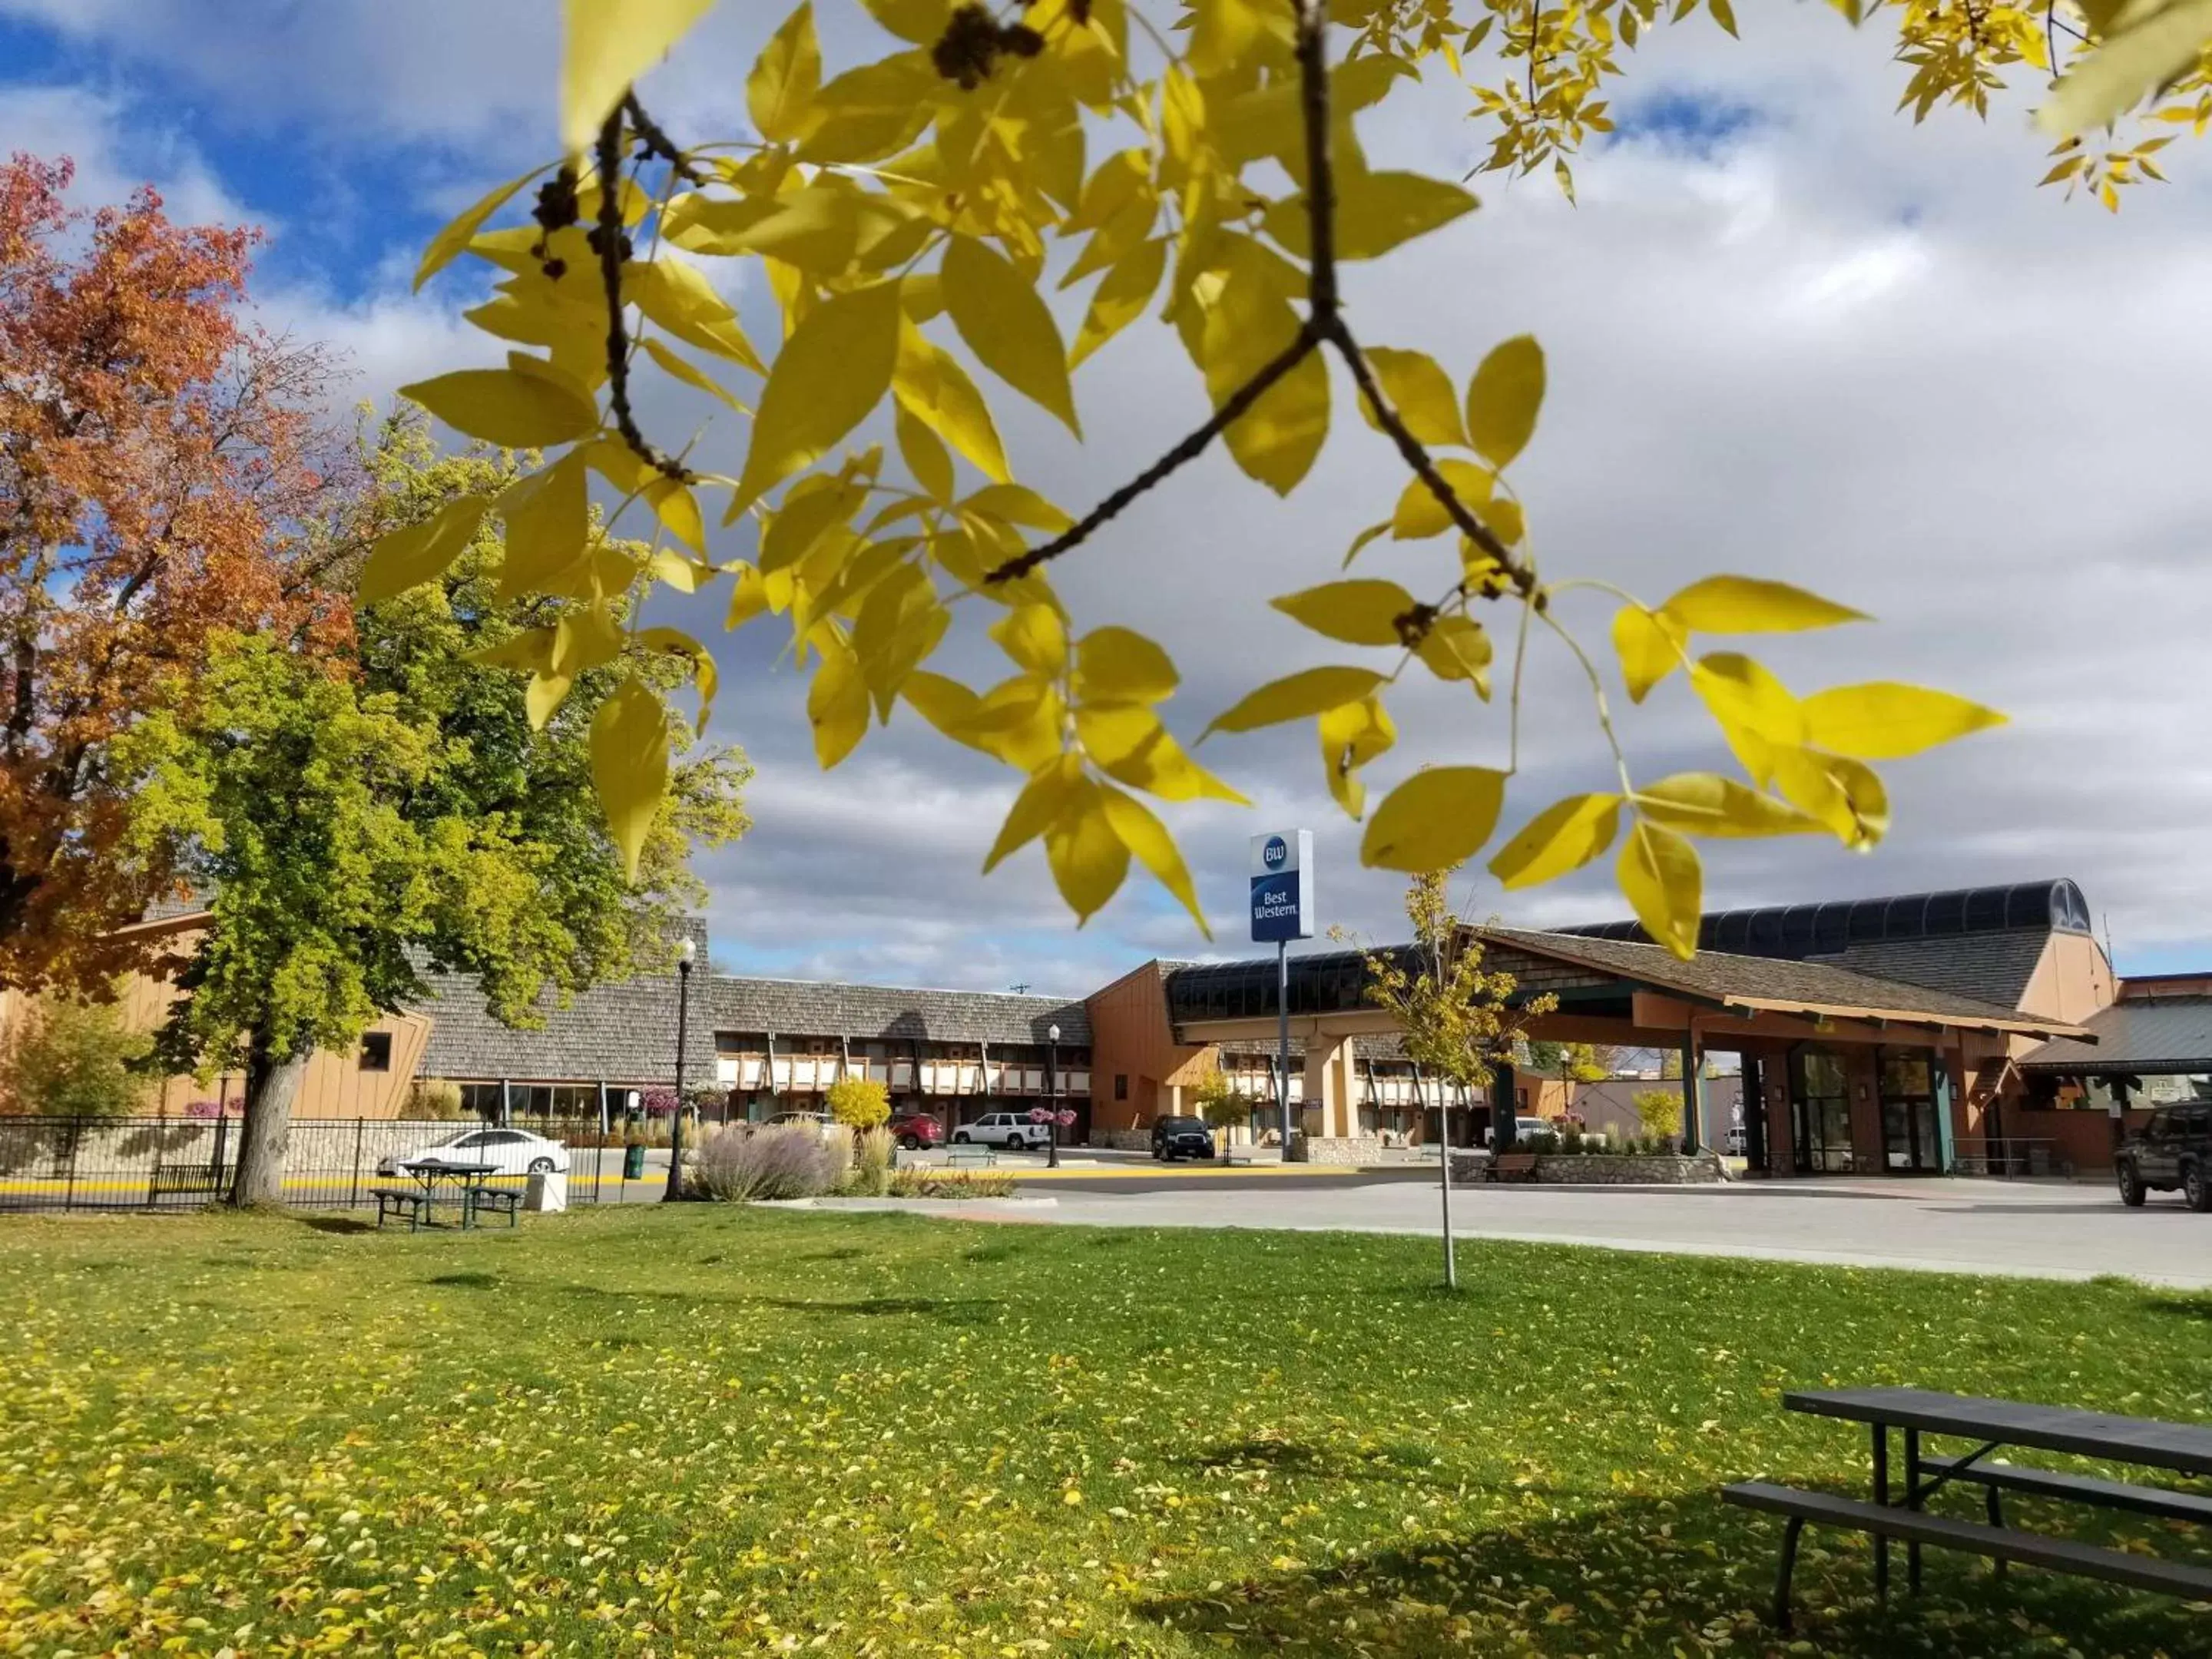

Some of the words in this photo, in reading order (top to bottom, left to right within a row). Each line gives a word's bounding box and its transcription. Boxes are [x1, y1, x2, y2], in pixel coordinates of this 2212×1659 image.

[1266, 846, 1284, 862] BW
[1264, 891, 1286, 905] Best
[1254, 904, 1296, 919] Western
